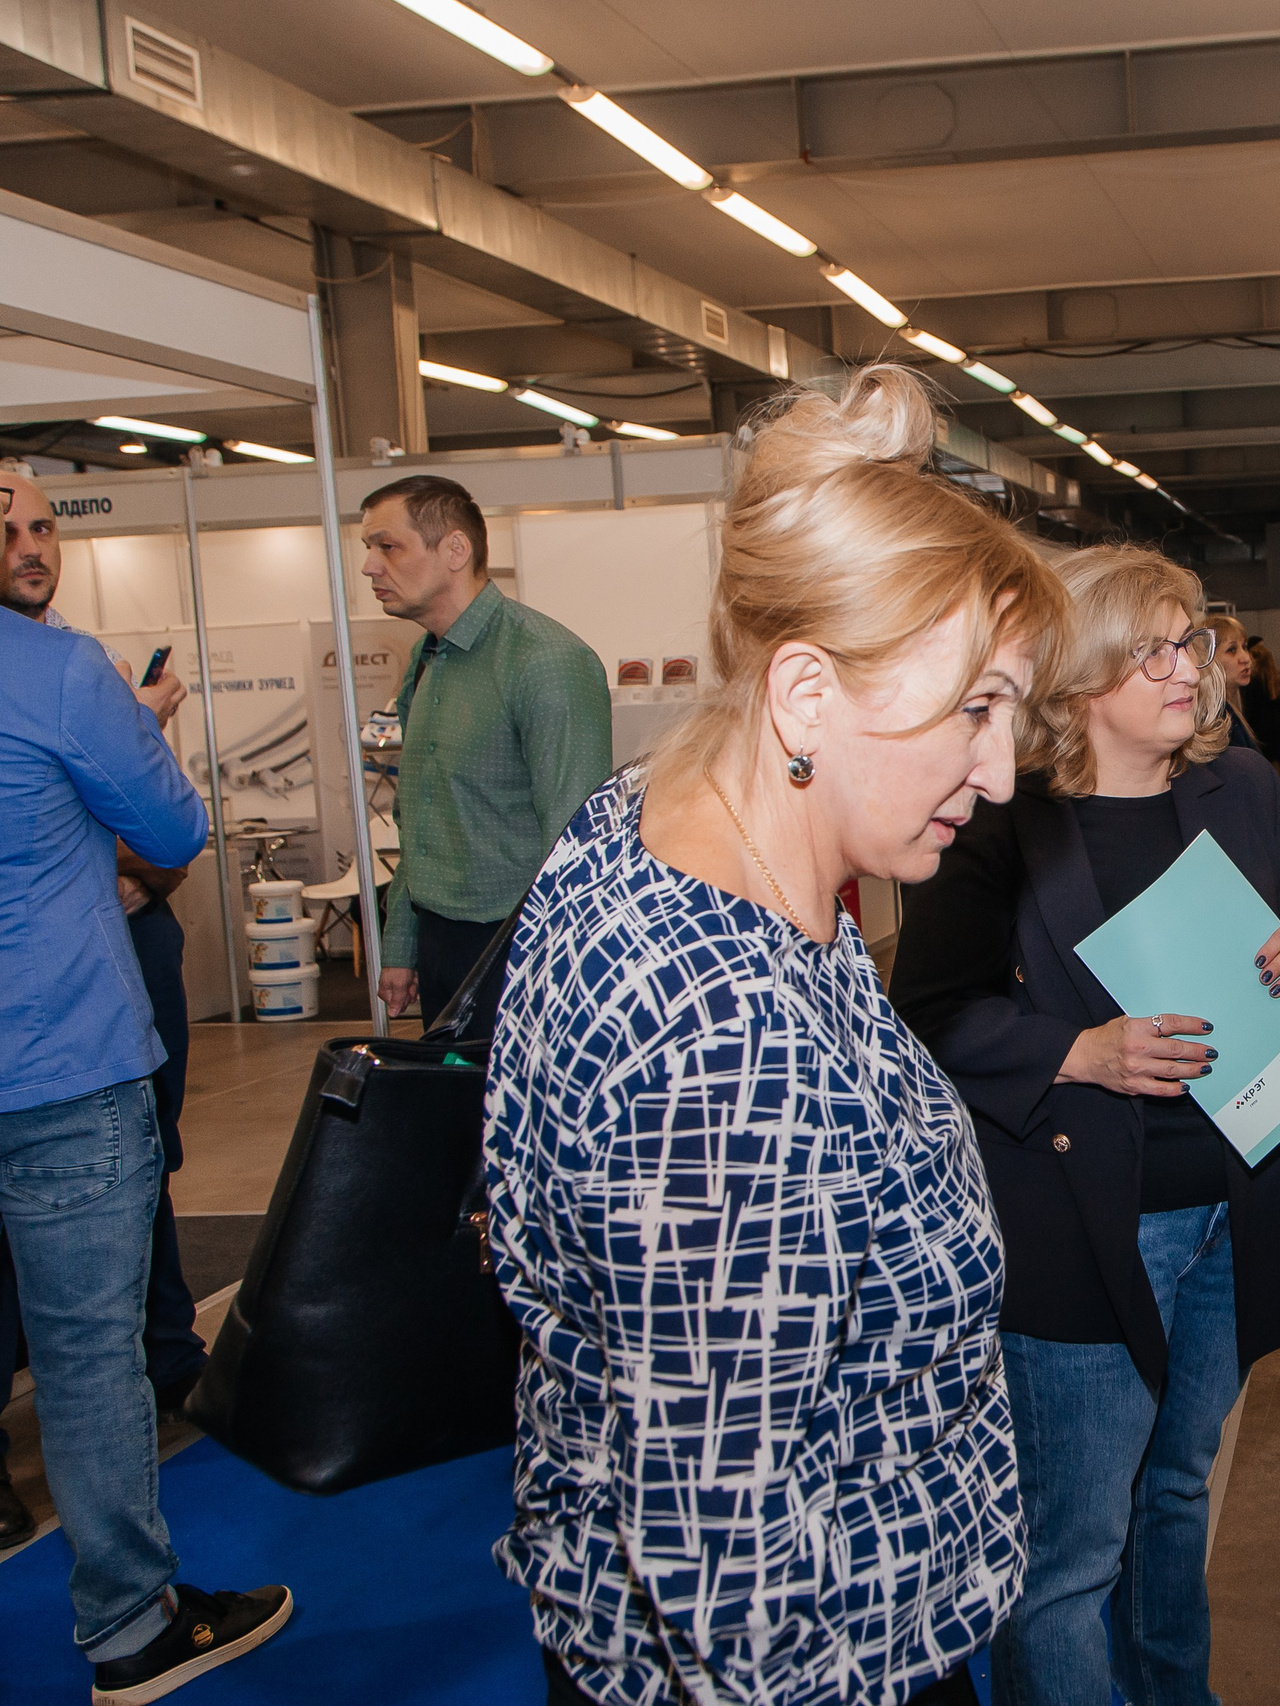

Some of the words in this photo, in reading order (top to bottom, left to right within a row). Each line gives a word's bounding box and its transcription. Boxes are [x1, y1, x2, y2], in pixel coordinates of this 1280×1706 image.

[322, 651, 390, 667] ДЕСТ
[258, 676, 295, 691] ЗУРМЕД
[1242, 1077, 1266, 1102] КРЭТ
